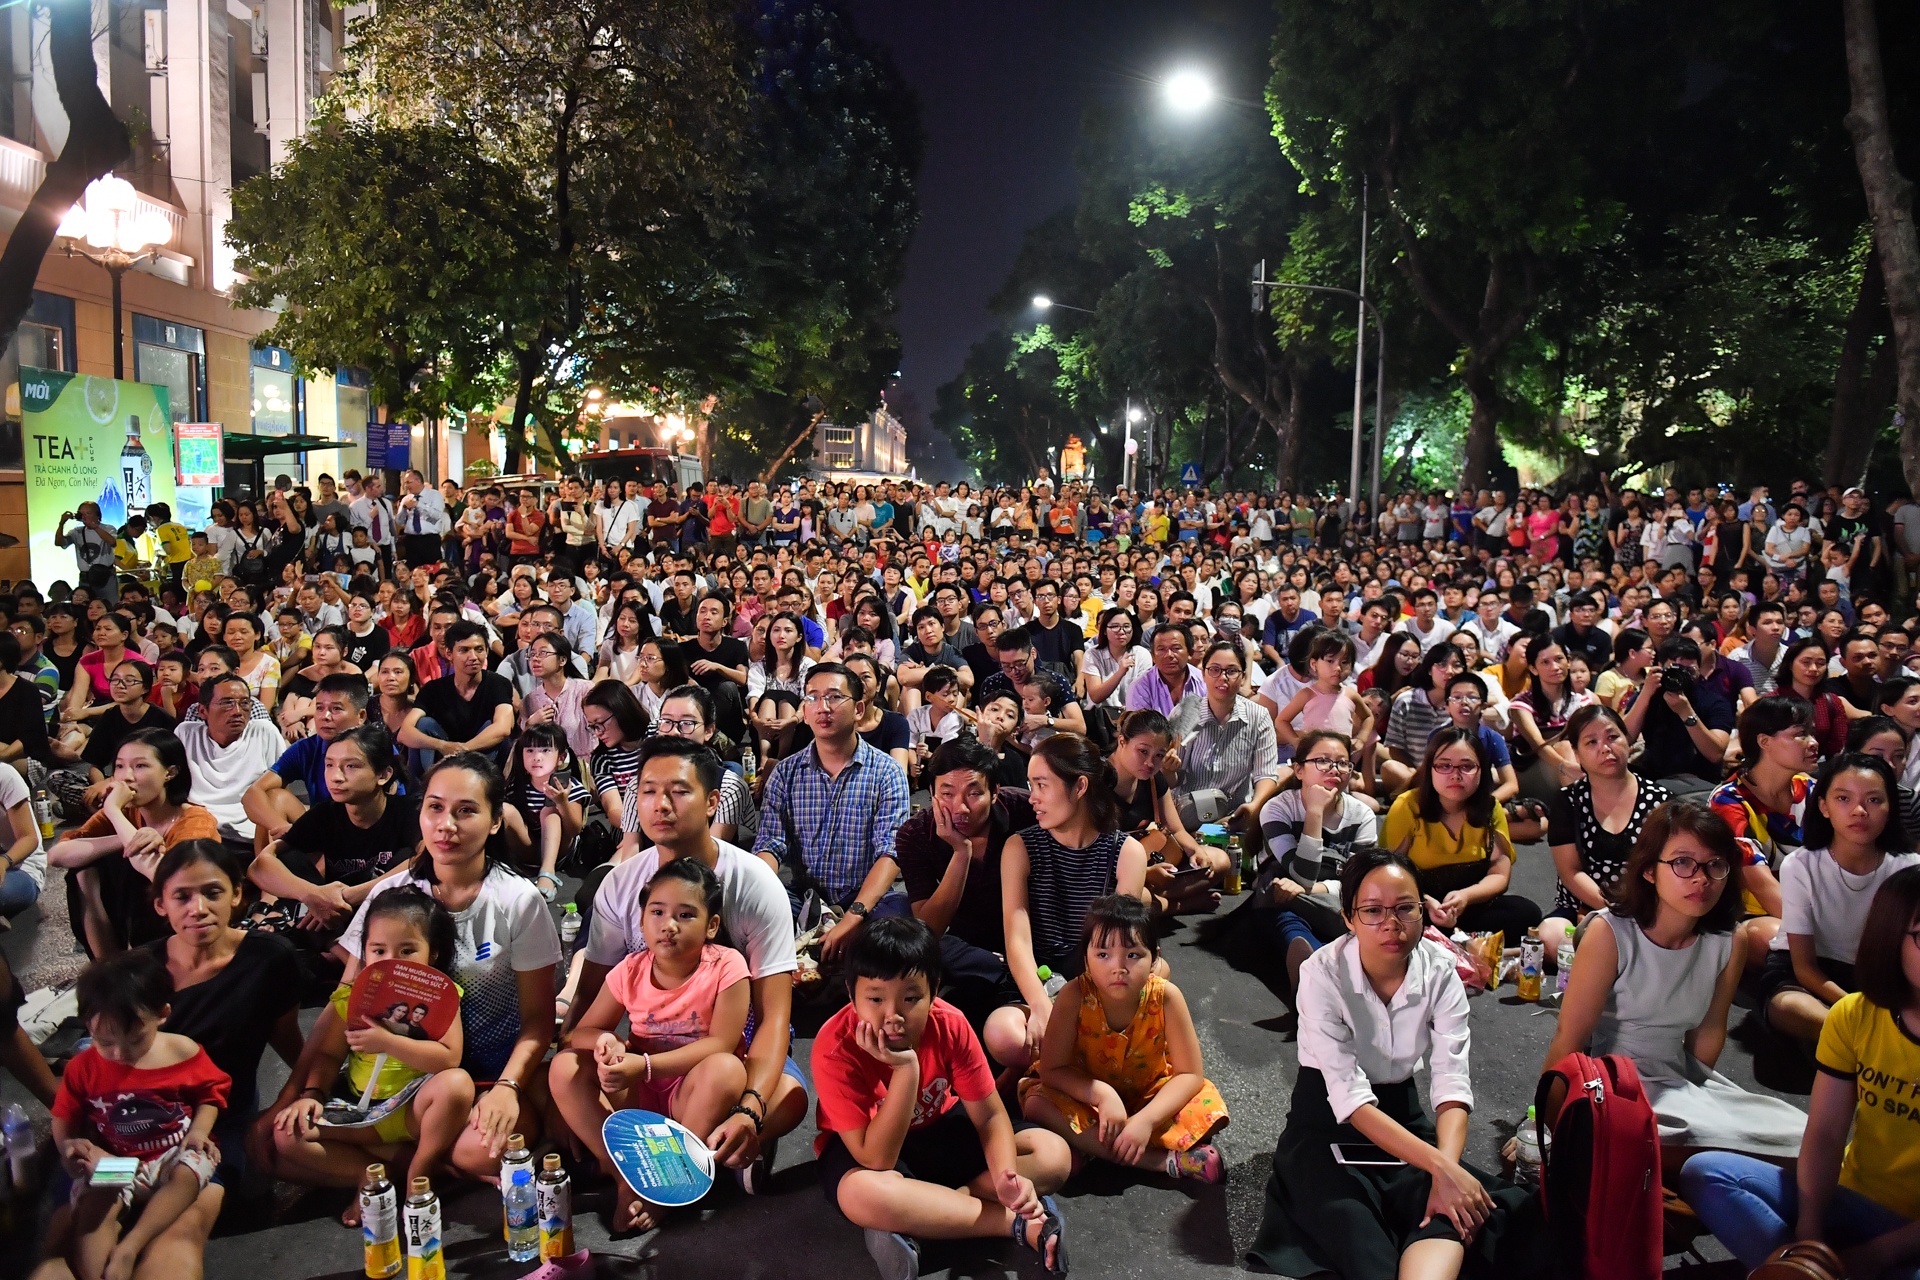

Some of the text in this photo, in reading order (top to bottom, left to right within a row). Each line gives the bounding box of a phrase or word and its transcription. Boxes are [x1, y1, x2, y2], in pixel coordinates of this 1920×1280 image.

[25, 380, 50, 400] MỚI
[34, 463, 46, 474] TRÀ
[48, 465, 71, 474] CHANH
[80, 466, 98, 475] LONG
[410, 1216, 419, 1237] TEA
